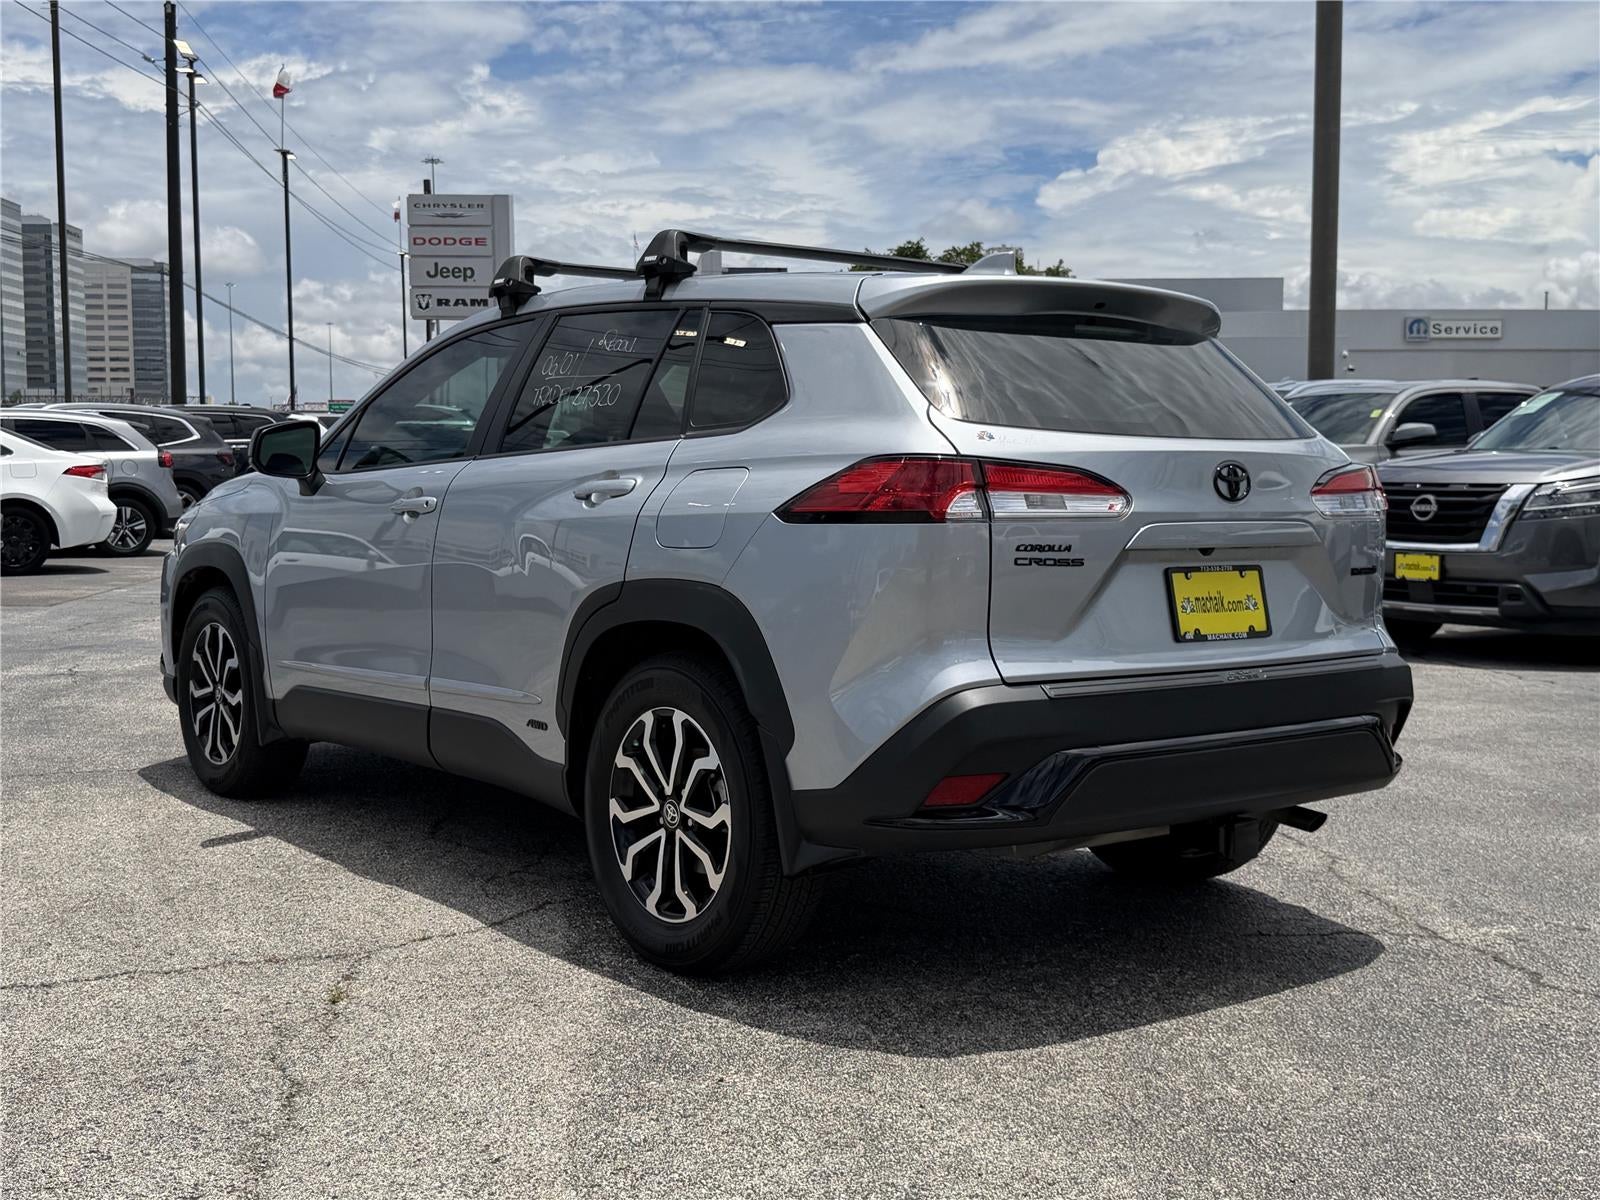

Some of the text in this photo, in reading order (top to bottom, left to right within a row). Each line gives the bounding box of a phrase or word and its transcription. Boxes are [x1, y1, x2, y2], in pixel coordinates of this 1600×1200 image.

[412, 237, 489, 247] DODGE
[425, 262, 476, 282] Jeep
[436, 298, 489, 308] RAM
[1431, 323, 1499, 335] Service
[1015, 544, 1072, 553] COROLLA
[1014, 557, 1085, 567] CROSS
[1194, 590, 1245, 614] machaik.com
